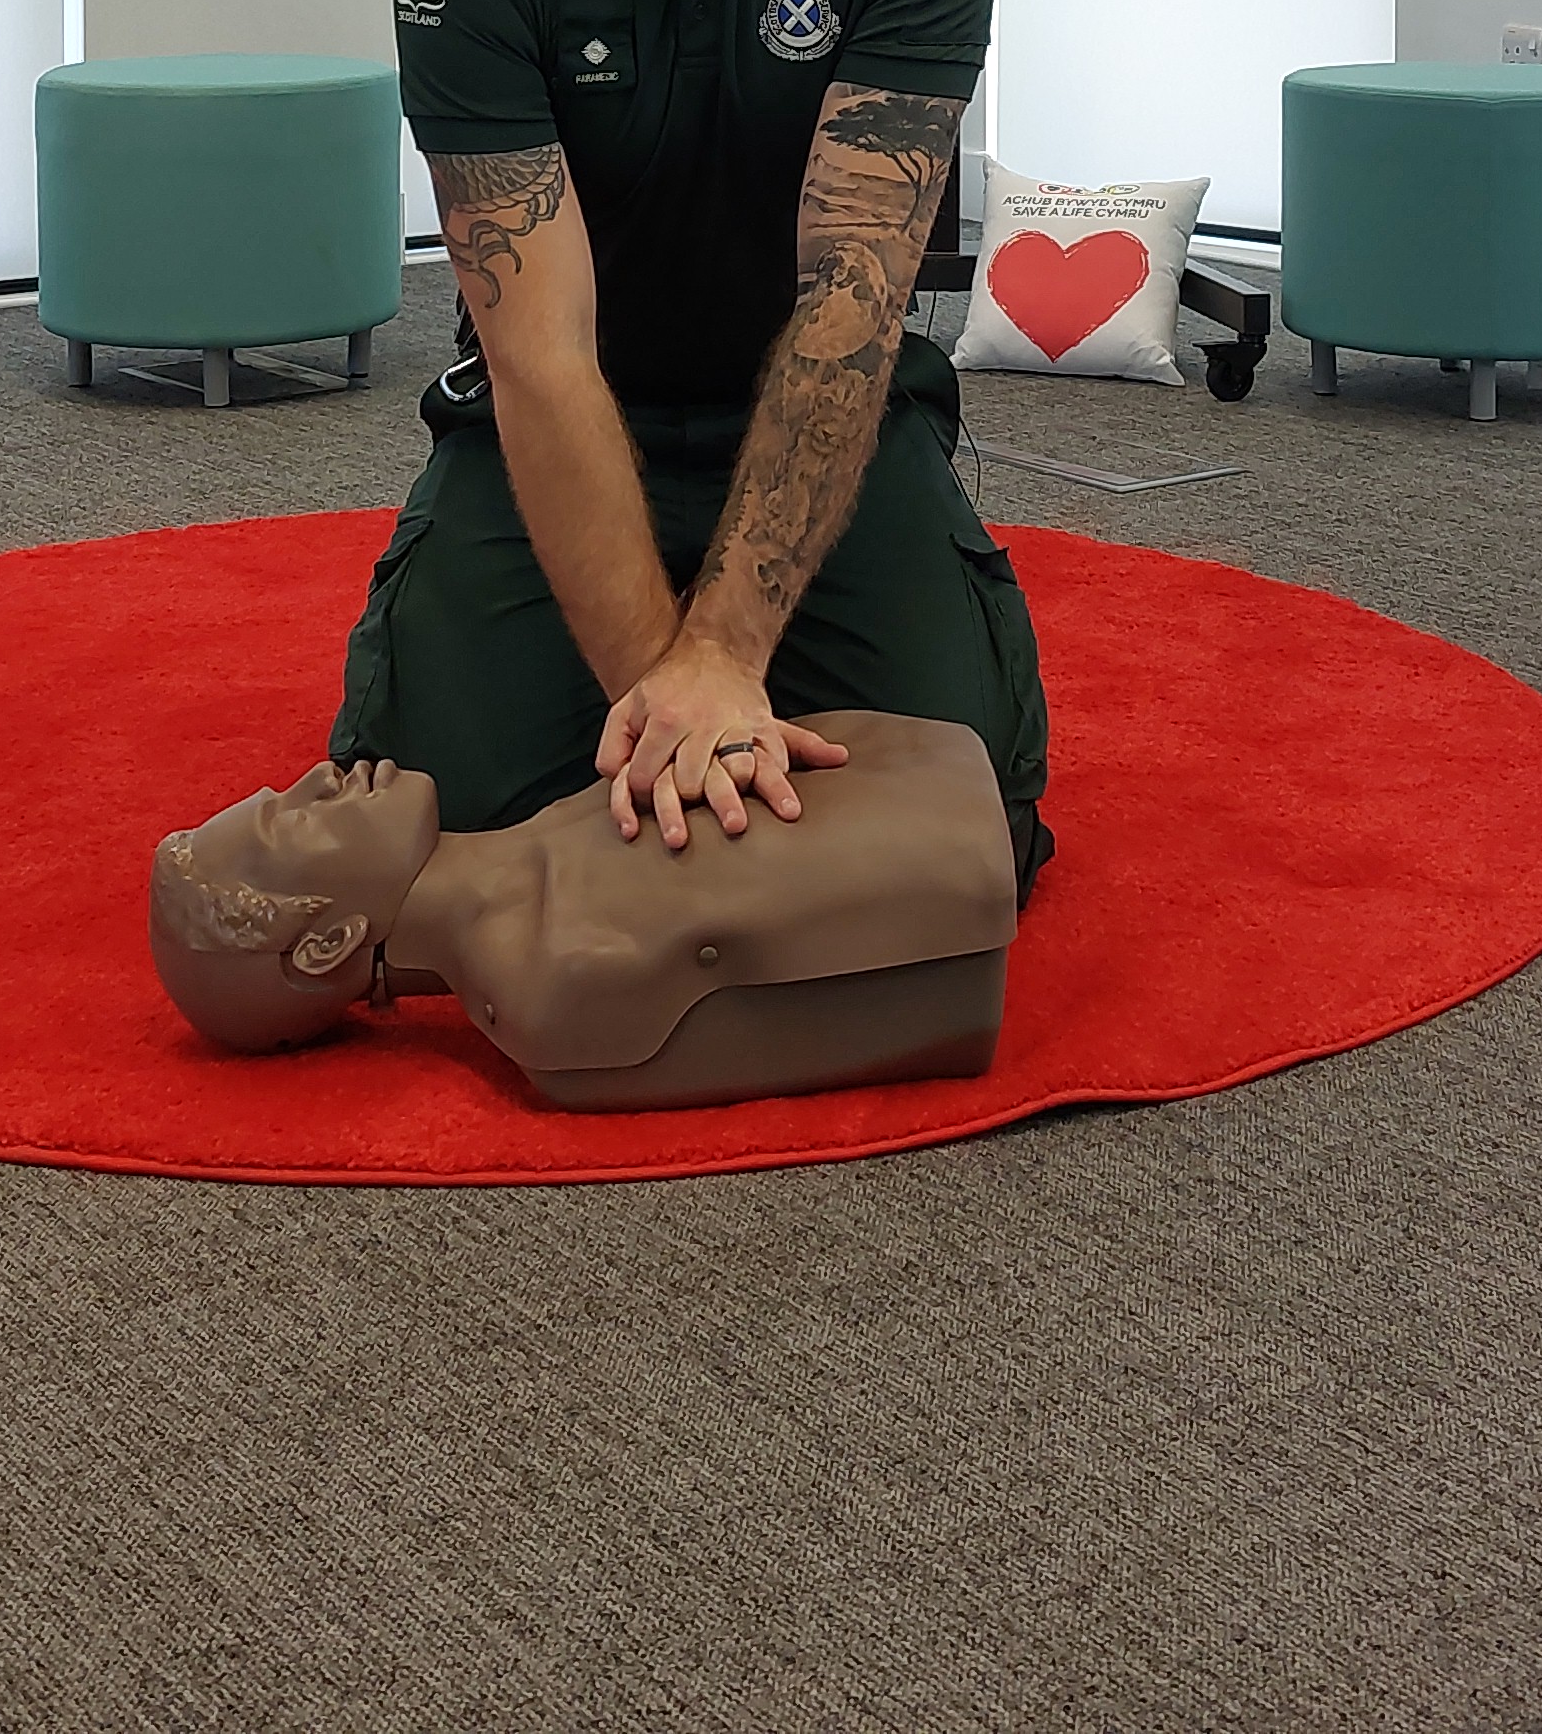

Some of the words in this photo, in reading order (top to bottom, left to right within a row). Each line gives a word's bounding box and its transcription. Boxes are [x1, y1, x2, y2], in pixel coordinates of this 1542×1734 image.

[397, 10, 442, 27] SCOTLAND
[1002, 195, 1053, 206] ACHUB
[1055, 197, 1109, 207] BYWYD
[1113, 198, 1167, 210] CYMRU
[1011, 206, 1047, 217] SAVE
[1049, 206, 1059, 216] A
[1062, 207, 1094, 217] LIFE
[1095, 208, 1150, 219] CYMRU
